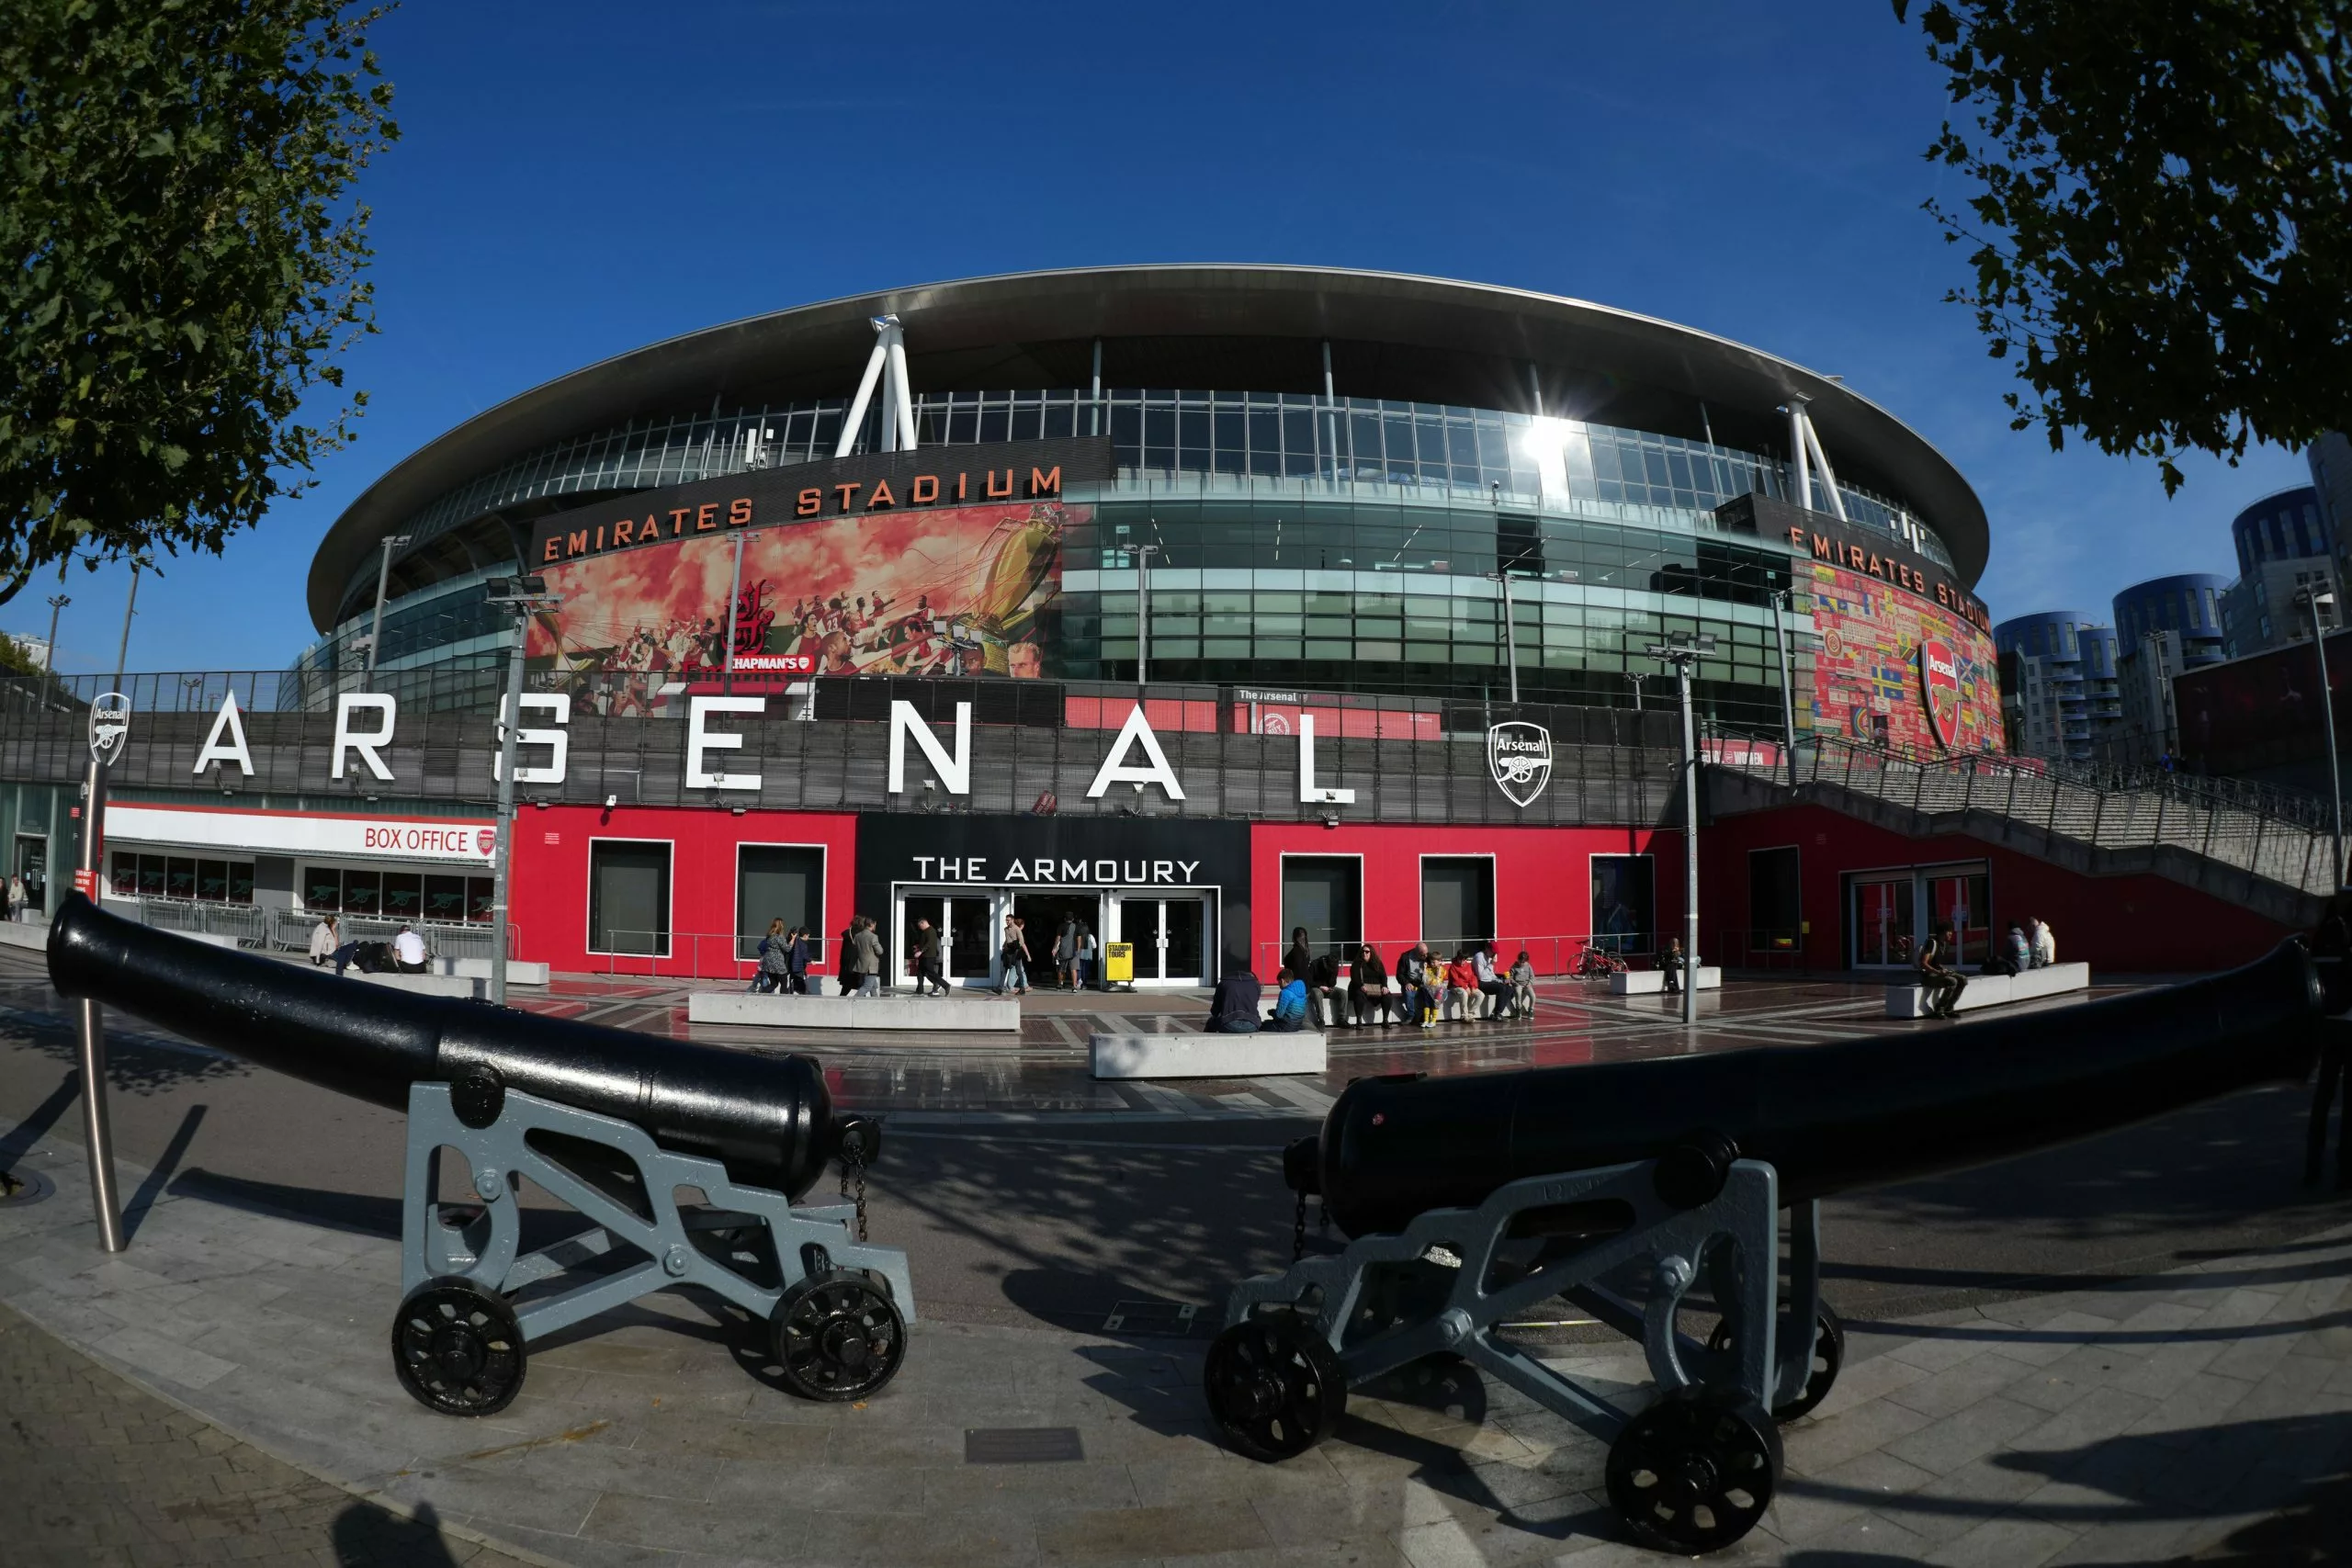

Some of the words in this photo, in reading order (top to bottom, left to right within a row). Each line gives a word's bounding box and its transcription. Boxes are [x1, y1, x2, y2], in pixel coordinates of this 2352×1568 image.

[544, 498, 752, 562] EMIRATES
[797, 467, 1061, 515] STADIUM
[1790, 526, 1925, 592] EMIRATES
[1929, 655, 1958, 678] Arsenal
[1240, 690, 1258, 700] The
[1260, 692, 1297, 702] Arsenal
[96, 707, 126, 720] Arsenal
[193, 689, 1355, 804] ARSENAL
[1497, 738, 1544, 752] Arsenal
[365, 828, 401, 849] BOX
[407, 829, 468, 852] OFFICE
[913, 856, 988, 881] THE
[1005, 858, 1200, 884] ARMOURY
